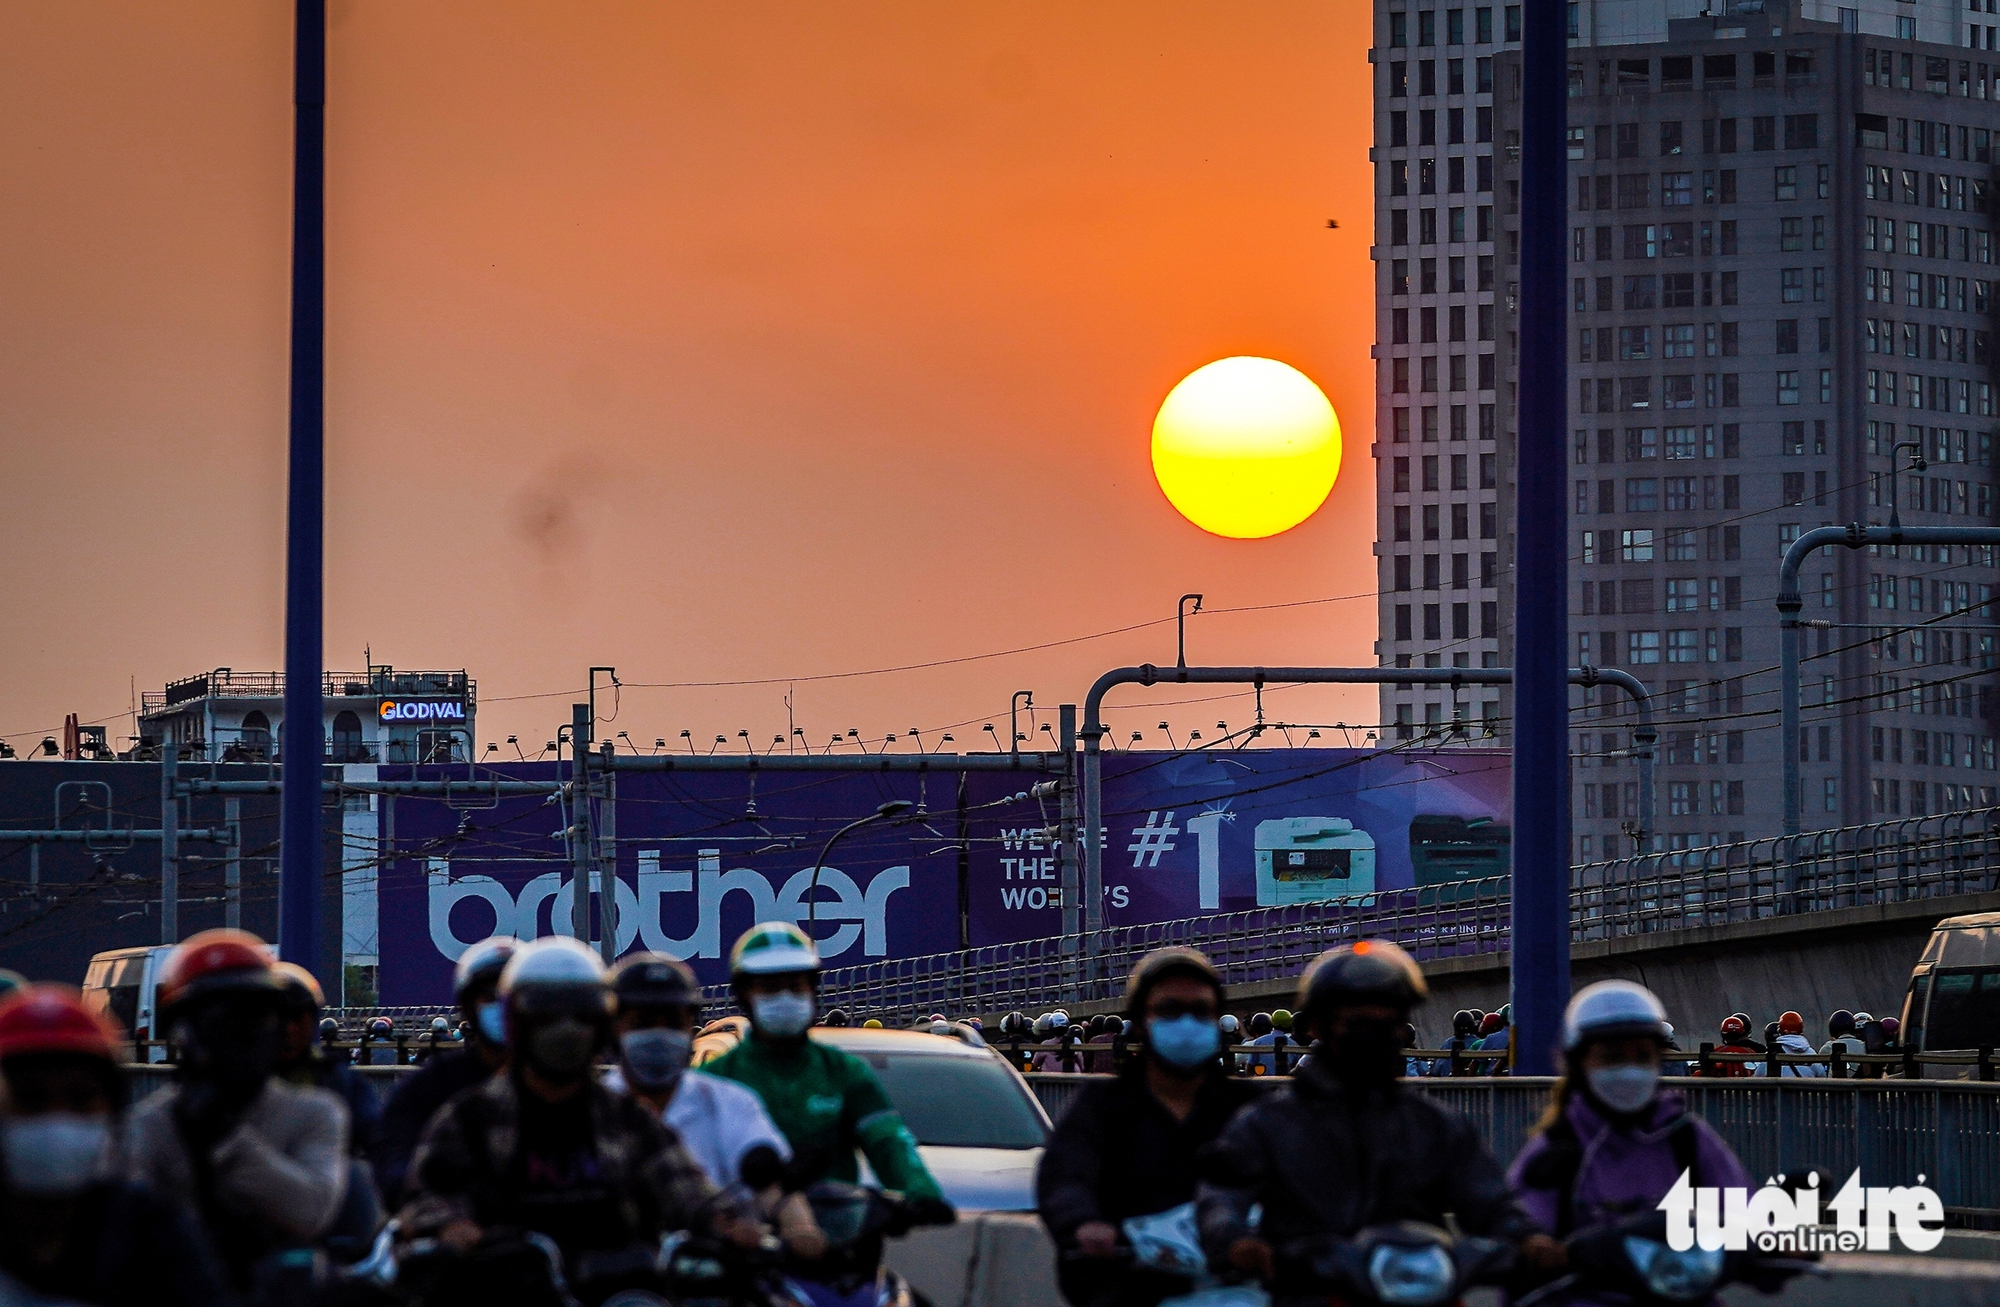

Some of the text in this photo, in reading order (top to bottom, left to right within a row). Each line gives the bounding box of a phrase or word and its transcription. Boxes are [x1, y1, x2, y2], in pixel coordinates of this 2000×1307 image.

[380, 701, 465, 720] GLODIVAL
[1000, 828, 1044, 850] WE
[1000, 857, 1056, 880] THE
[428, 848, 910, 962] brother
